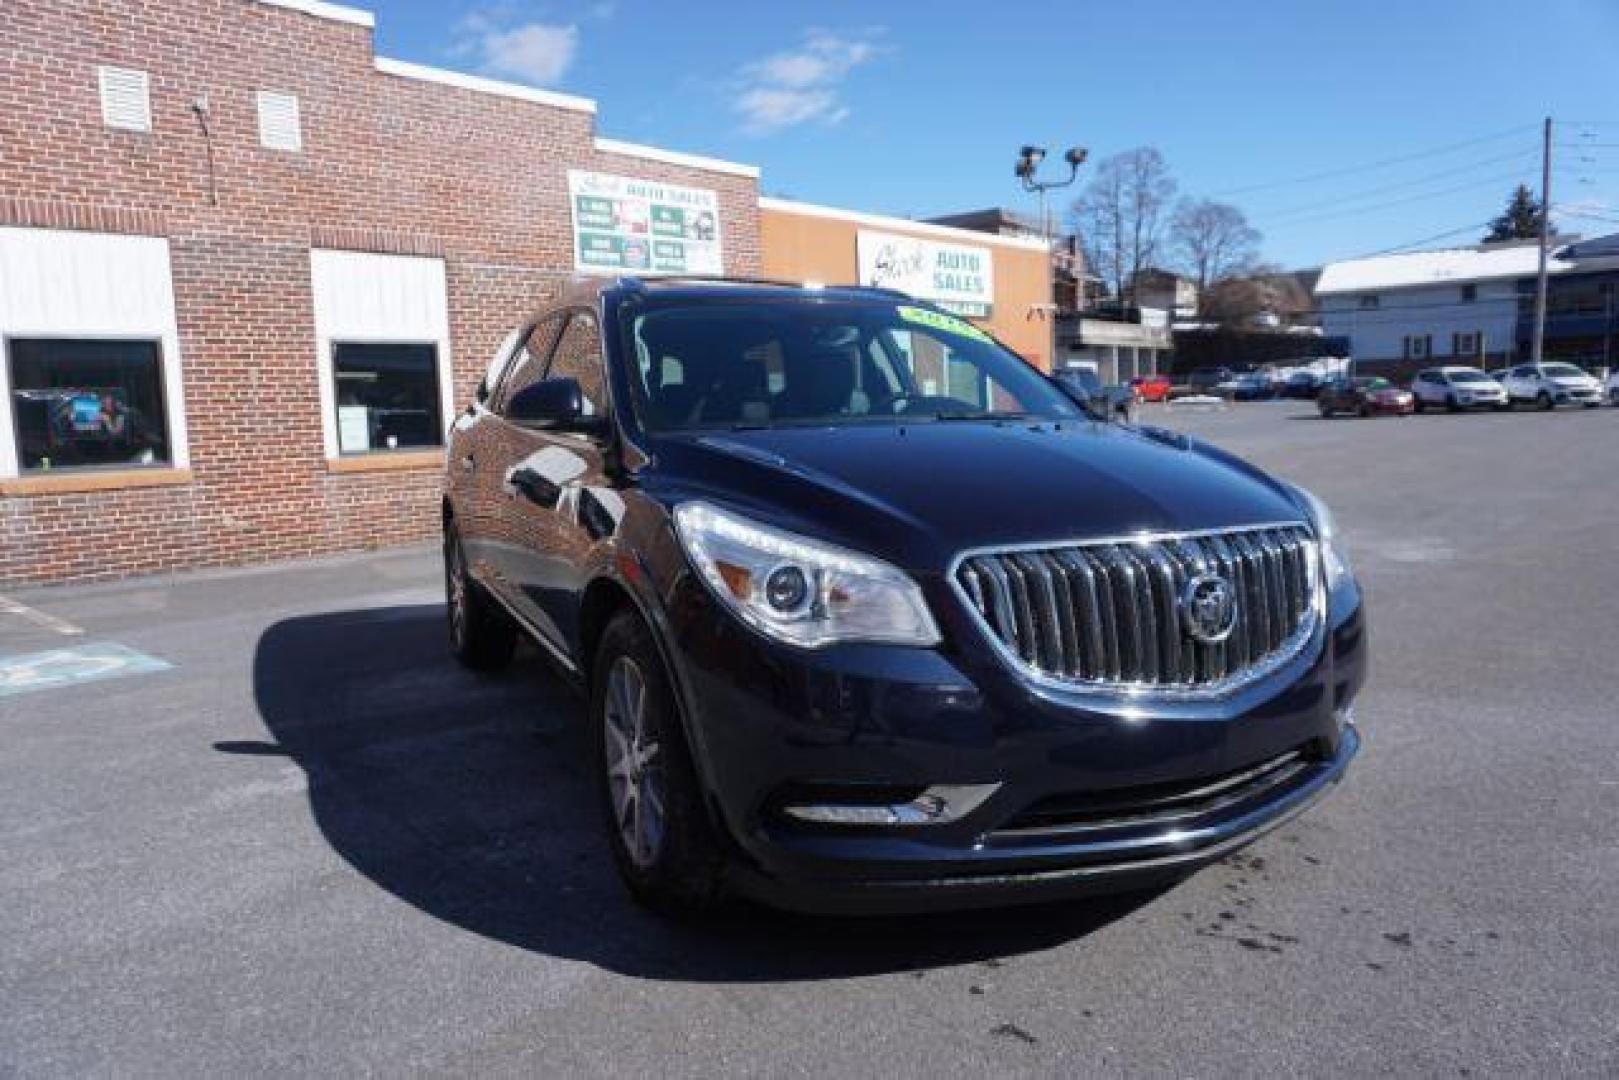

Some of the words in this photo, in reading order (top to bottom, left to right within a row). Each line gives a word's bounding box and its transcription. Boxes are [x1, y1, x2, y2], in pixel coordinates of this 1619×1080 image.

[626, 183, 665, 200] AUTO
[936, 249, 981, 272] AUTO
[933, 271, 985, 293] SALES
